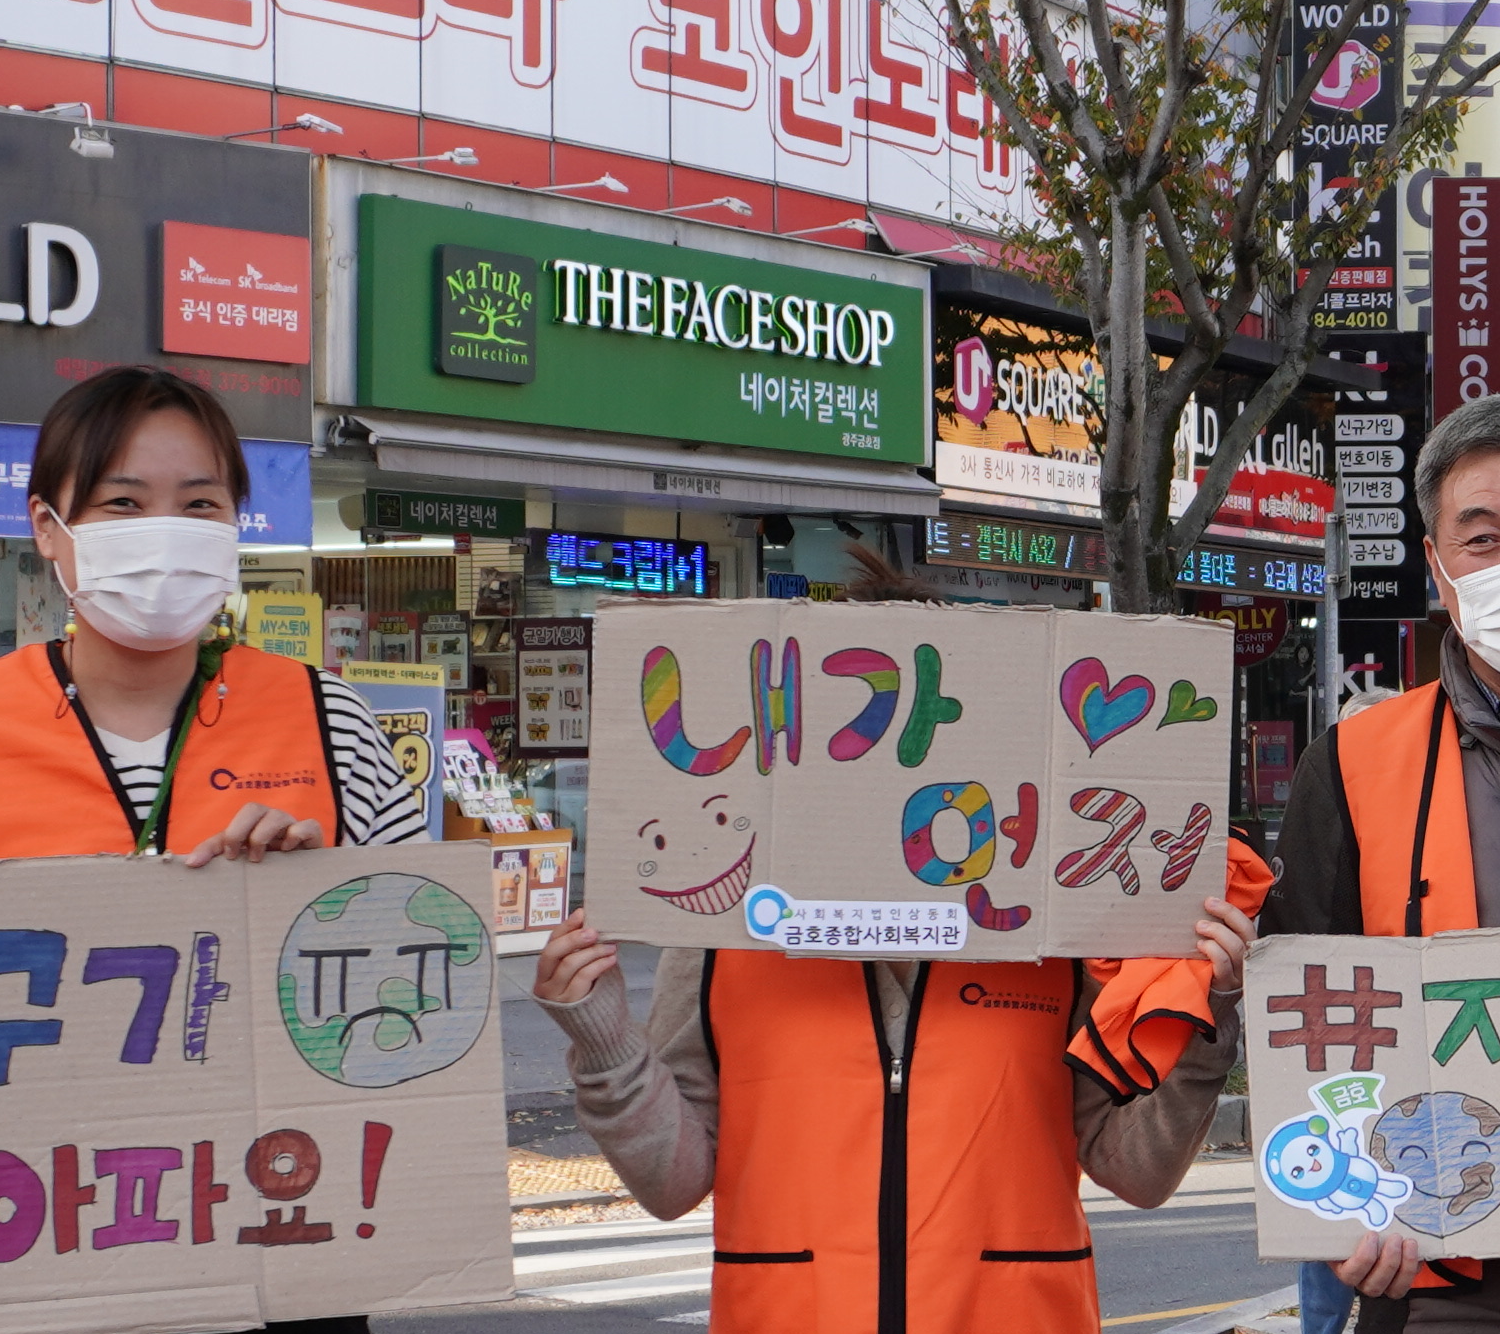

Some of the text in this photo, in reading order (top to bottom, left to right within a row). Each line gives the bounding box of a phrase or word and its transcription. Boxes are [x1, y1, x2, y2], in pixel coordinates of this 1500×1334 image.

[1302, 123, 1388, 146] SQUARE
[1459, 185, 1488, 312] HOLLYS
[180, 269, 298, 294] SK telecom SK broadband
[180, 298, 298, 332] 공식 인증 대리점
[1312, 310, 1388, 328] 84-4010
[449, 344, 529, 366] collection
[739, 371, 879, 429] 네이처컬렉션
[997, 358, 1085, 425] SQUARE
[1338, 417, 1394, 437] 신규가입
[1339, 449, 1394, 468] 번호이동
[960, 455, 977, 474] 3사
[983, 456, 1015, 481] 통신사
[1021, 463, 1041, 486] 가격
[1046, 470, 1086, 492] 비교하여
[409, 500, 498, 529] 네이처컬렉션
[1349, 544, 1395, 563] 금수납
[260, 619, 310, 637] MY스토어
[1236, 632, 1274, 643] CENTER
[1342, 653, 1384, 695] kt
[642, 635, 964, 777] 내가
[784, 922, 961, 948] 금호종합사회복지관
[1333, 1079, 1370, 1109] 금호
